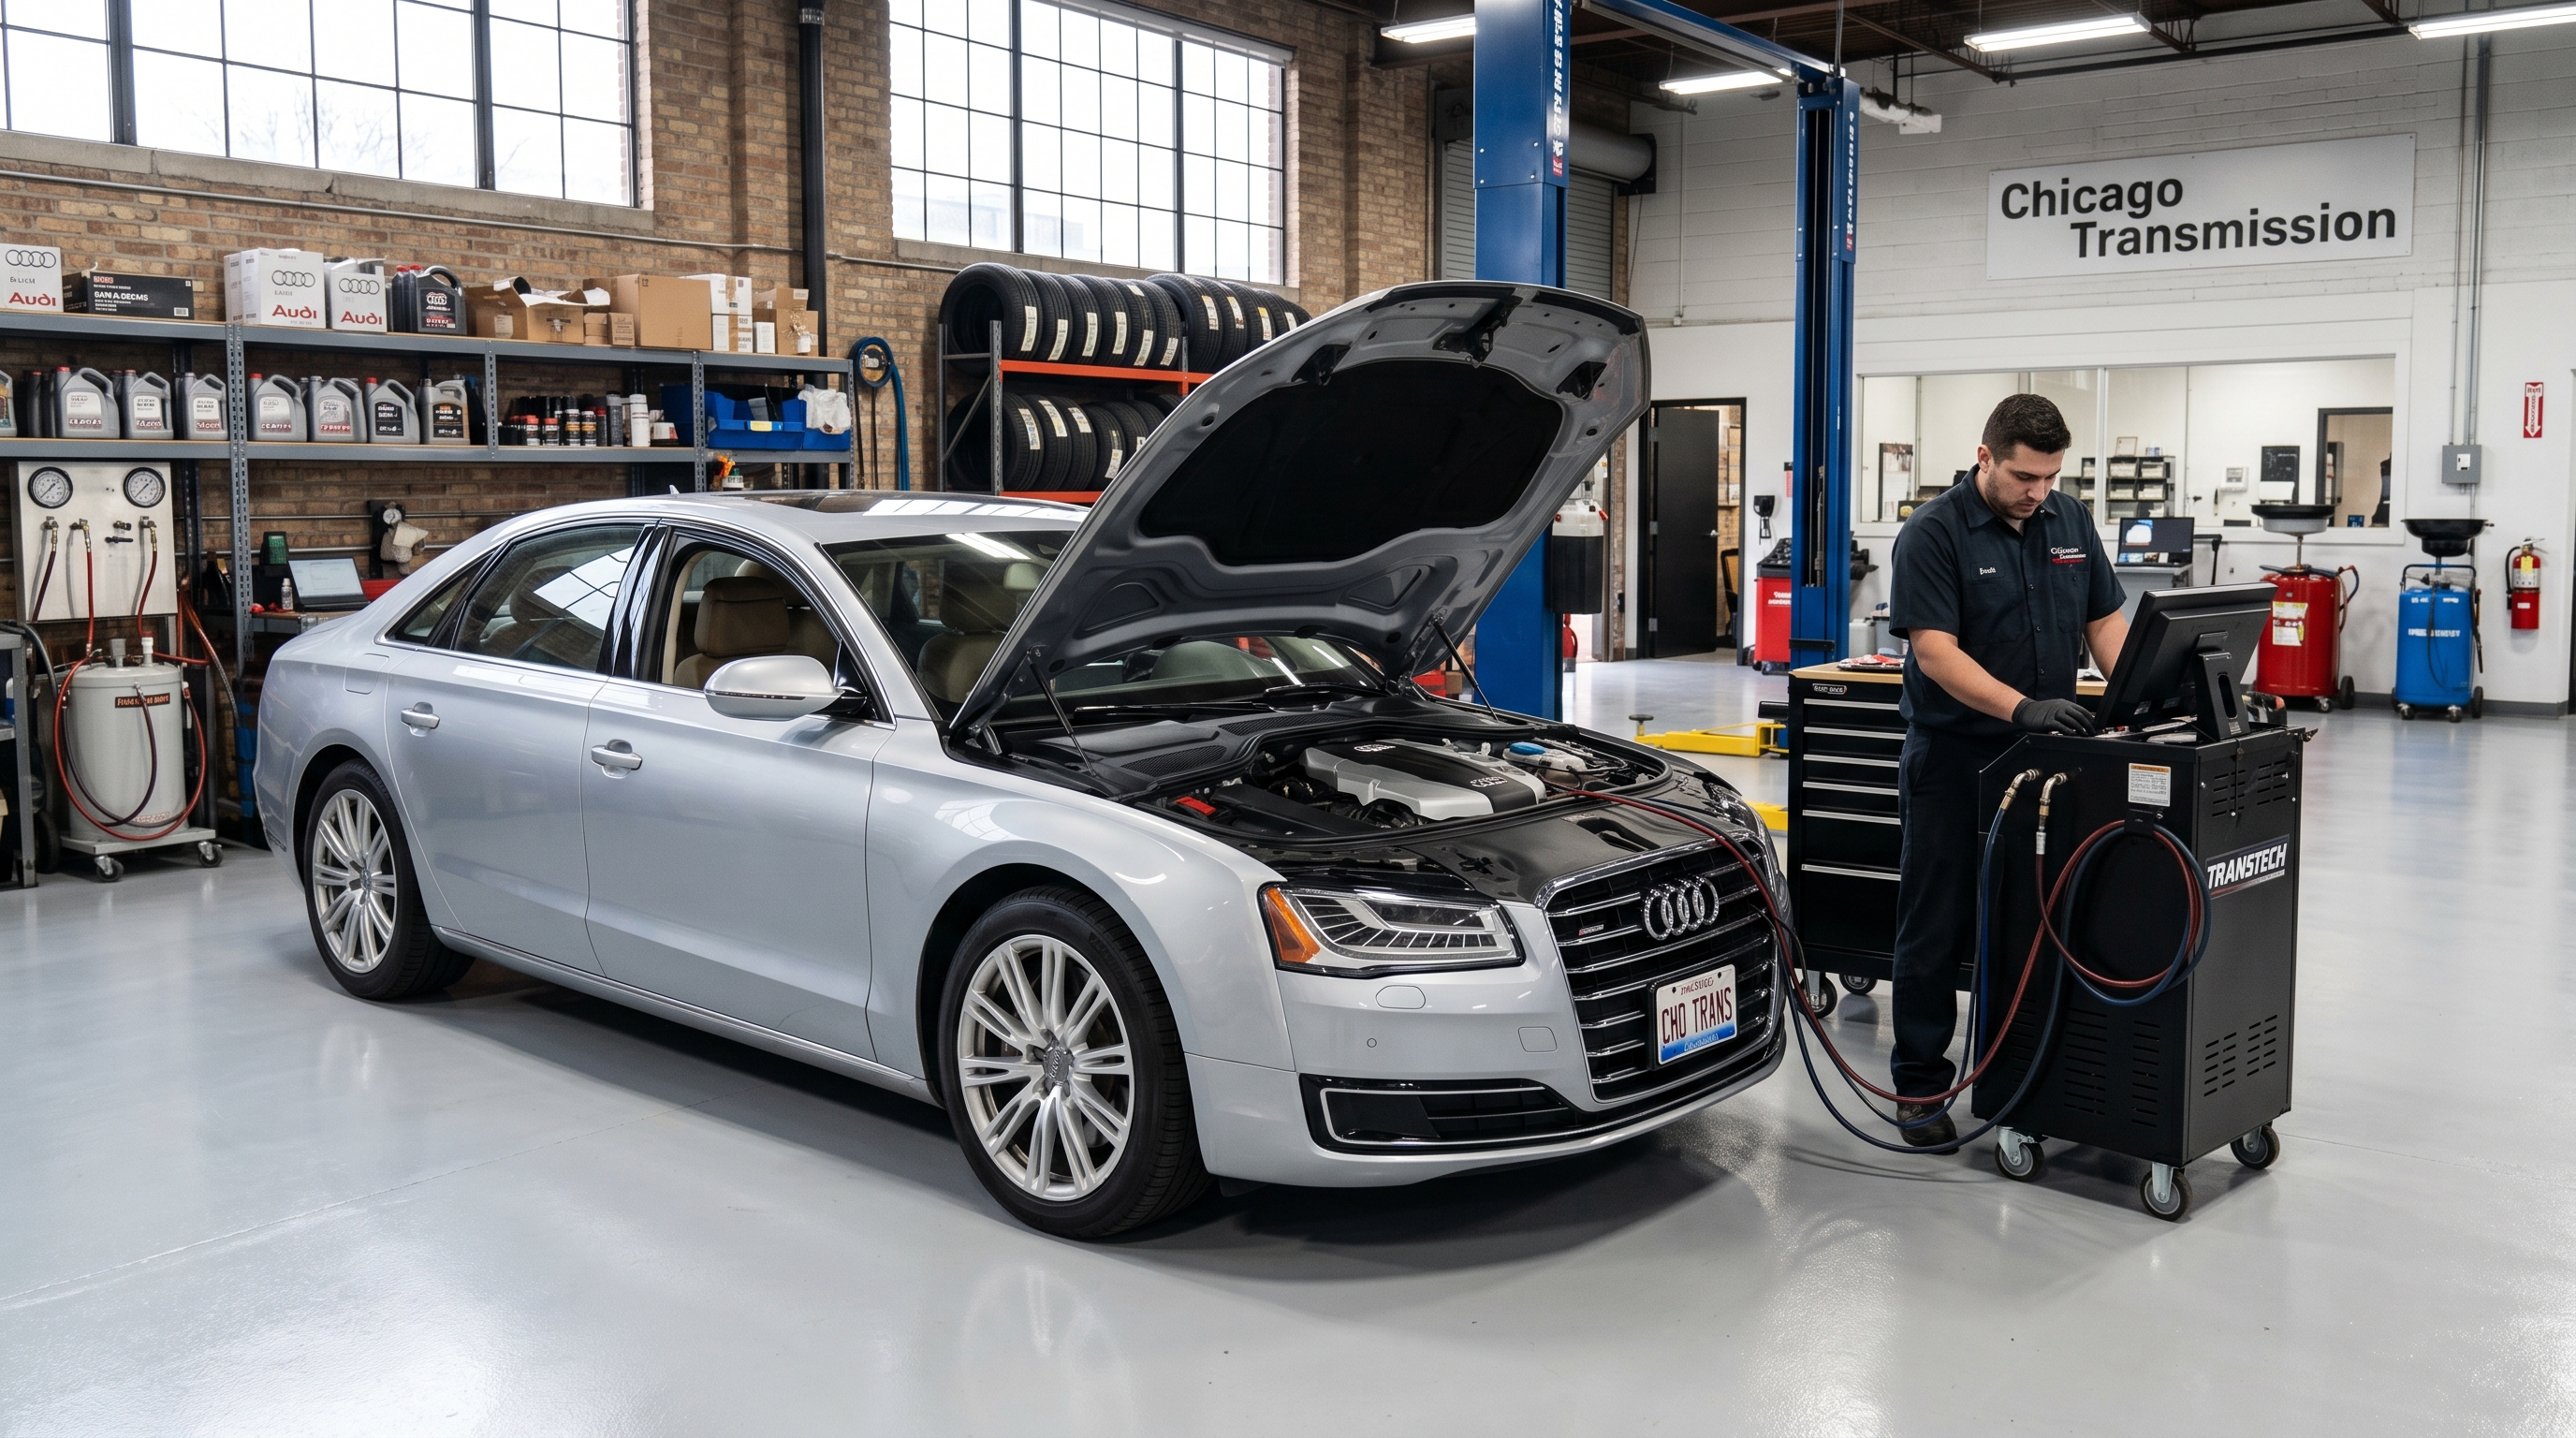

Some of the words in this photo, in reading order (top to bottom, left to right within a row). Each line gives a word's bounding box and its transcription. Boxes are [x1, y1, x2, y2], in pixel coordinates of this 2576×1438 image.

[2000, 176, 2184, 219] Chicago
[2071, 202, 2396, 258] Transmission
[8, 291, 56, 306] Audi
[271, 304, 317, 319] Audi
[340, 311, 383, 325] Audi
[2207, 843, 2288, 889] TRANSTECH
[1661, 1003, 1687, 1045] CHO
[1691, 986, 1733, 1034] TRANS
